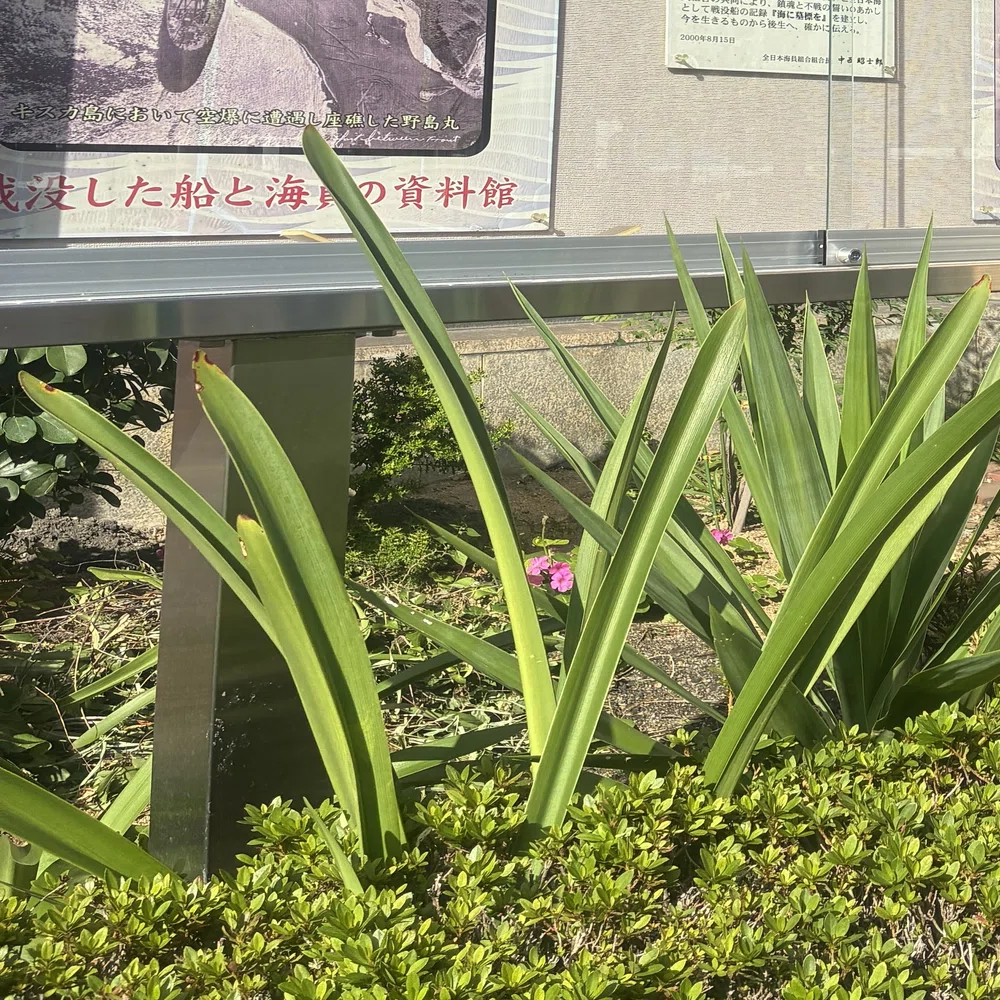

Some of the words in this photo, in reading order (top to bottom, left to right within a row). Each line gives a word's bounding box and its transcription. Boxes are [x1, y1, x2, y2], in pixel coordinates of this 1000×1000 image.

[680, 34, 736, 43] 2000年8月15日
[11, 103, 460, 131] キスカ島において空爆に遭遇し座礁した野島丸
[0, 173, 518, 212] 没した船と海の資料館
